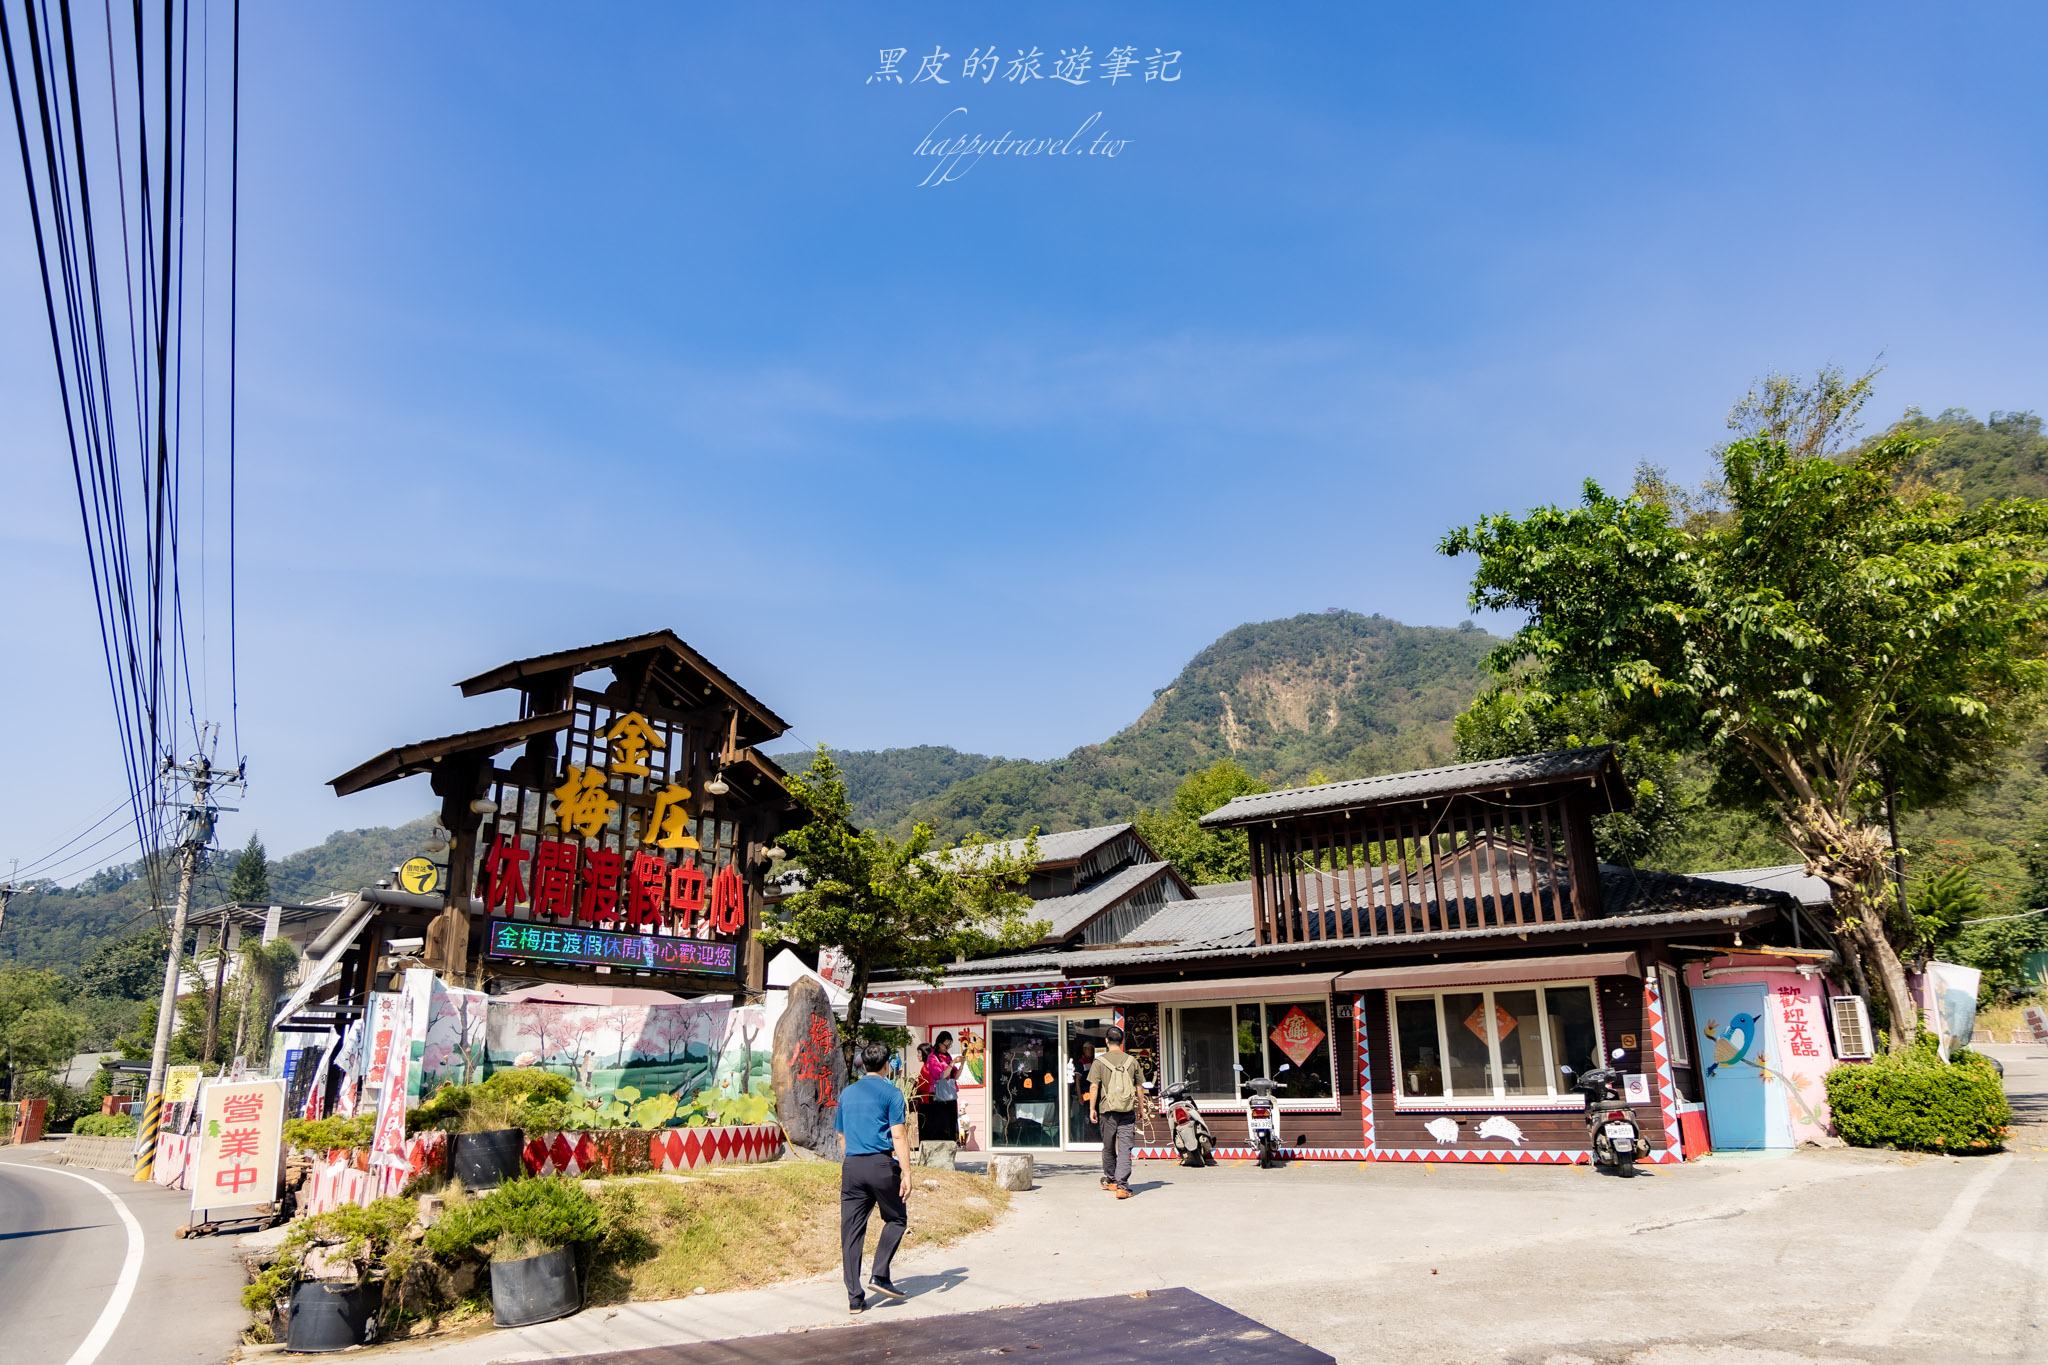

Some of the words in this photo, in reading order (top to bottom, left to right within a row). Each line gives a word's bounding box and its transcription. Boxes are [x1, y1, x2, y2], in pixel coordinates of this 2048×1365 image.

[484, 833, 745, 934] 休閒渡假中心
[1777, 986, 1820, 1056] 歡迎光臨
[215, 1092, 264, 1194] 營業中
